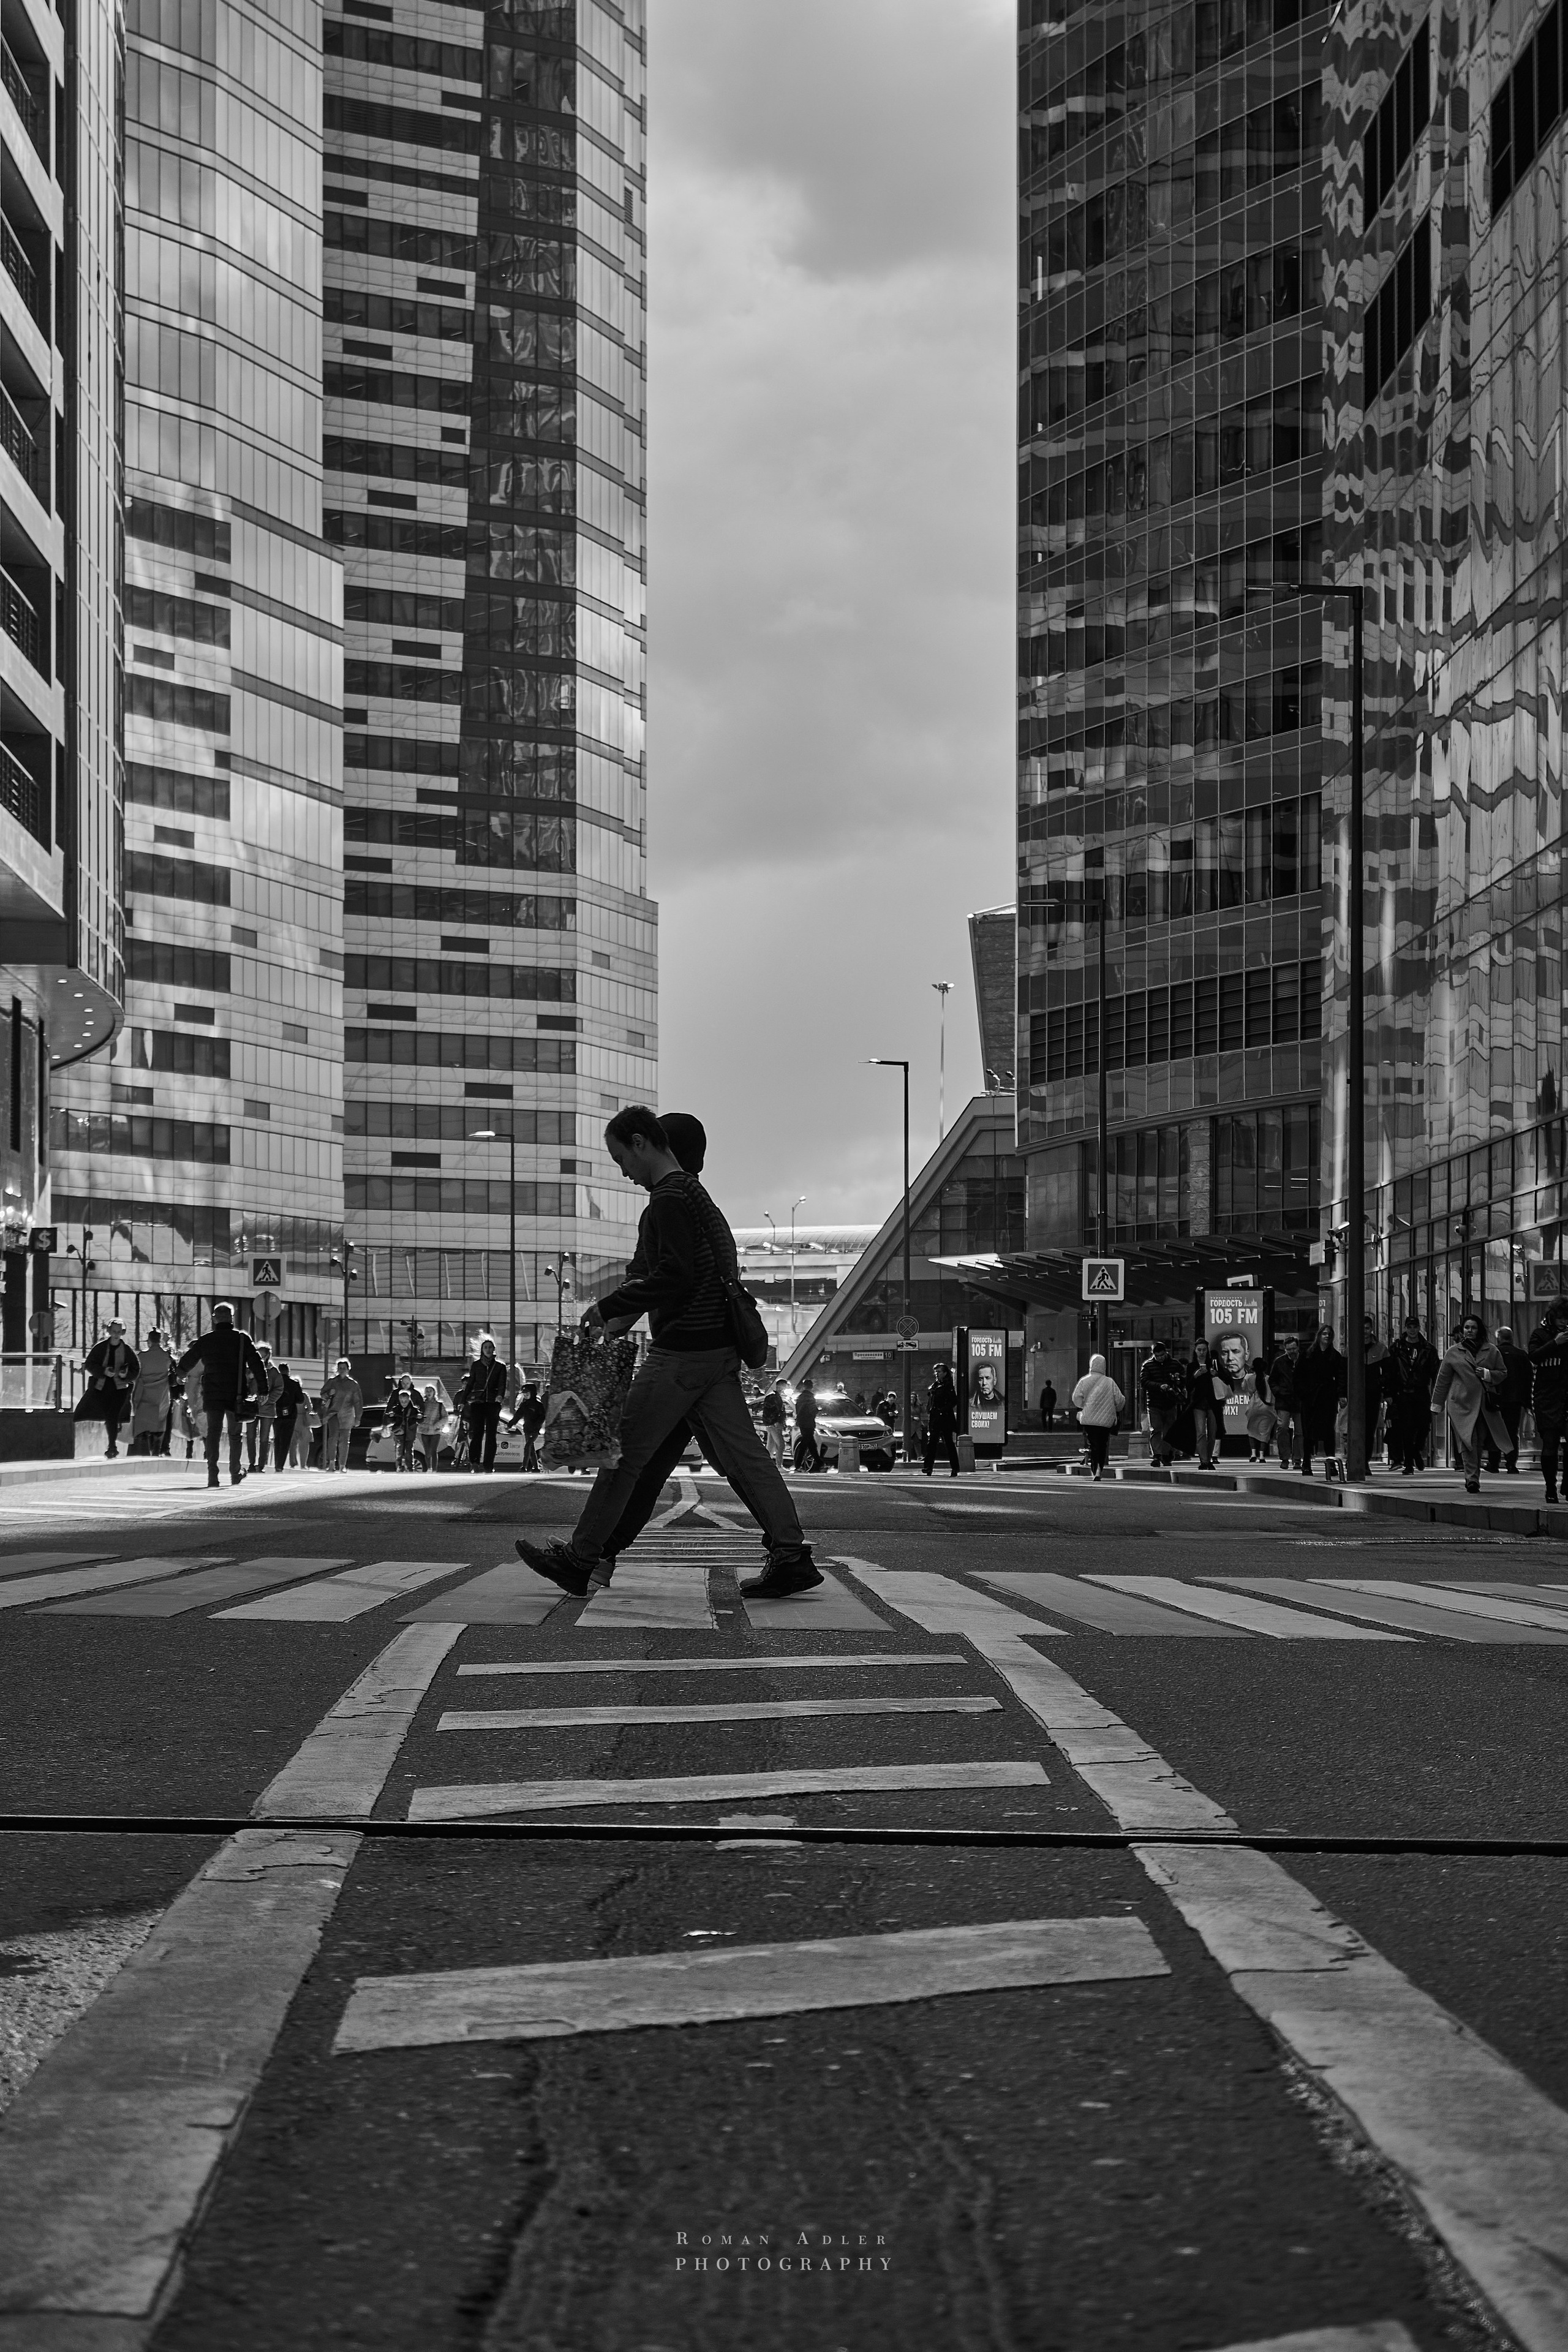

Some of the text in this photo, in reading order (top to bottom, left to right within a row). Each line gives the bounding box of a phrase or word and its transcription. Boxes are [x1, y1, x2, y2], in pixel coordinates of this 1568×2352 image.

[1210, 1308, 1258, 1324] 105 FM
[971, 1344, 1002, 1357] 105 FM
[1227, 1395, 1250, 1404] ШАЕМ
